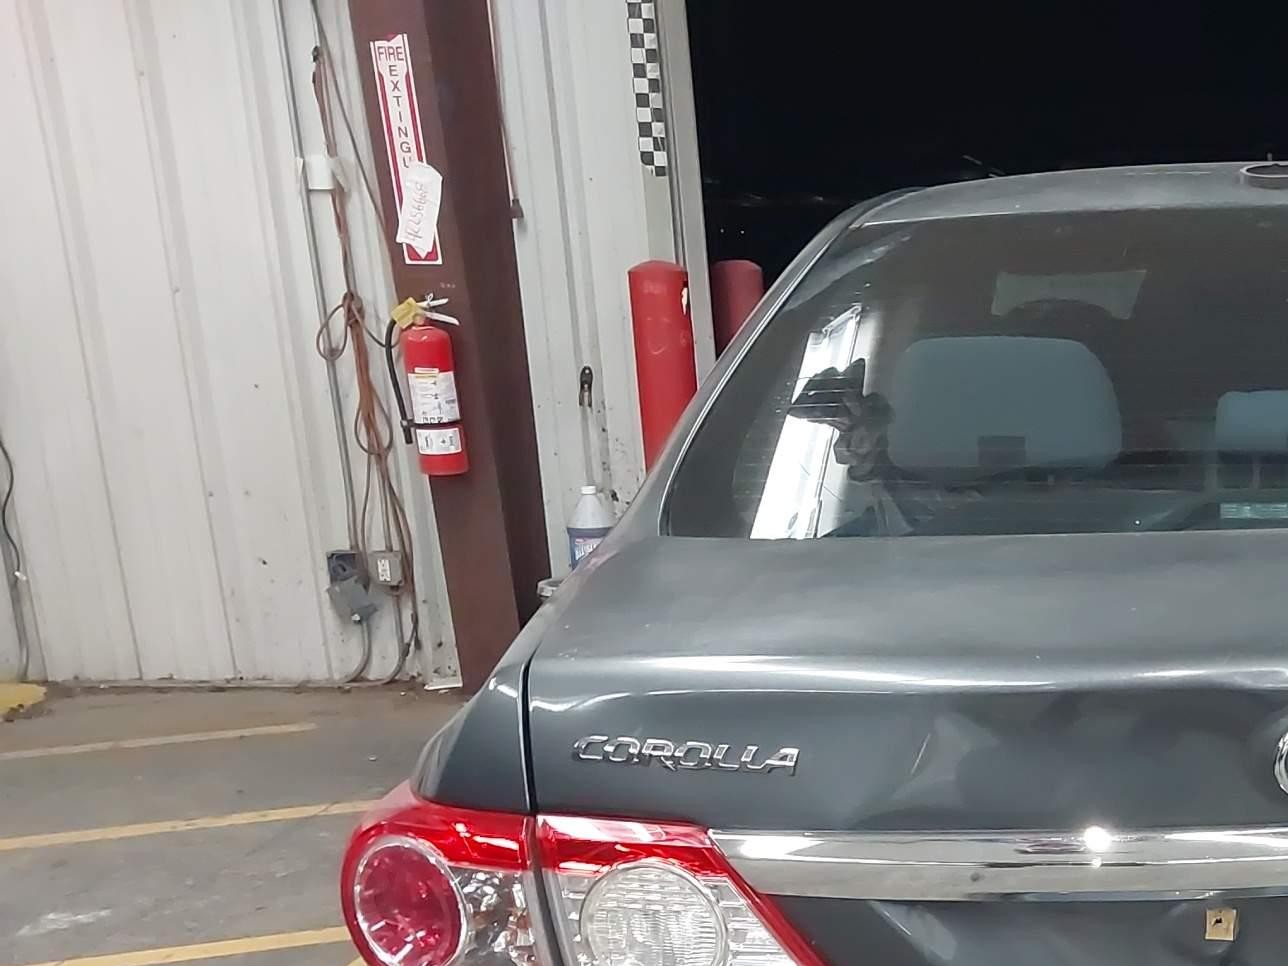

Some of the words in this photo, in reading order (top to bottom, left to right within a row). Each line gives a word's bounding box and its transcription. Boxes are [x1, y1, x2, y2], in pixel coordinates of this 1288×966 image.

[377, 46, 404, 62] FIRE
[388, 64, 412, 169] EXTINGU
[573, 735, 800, 776] COROLLA
